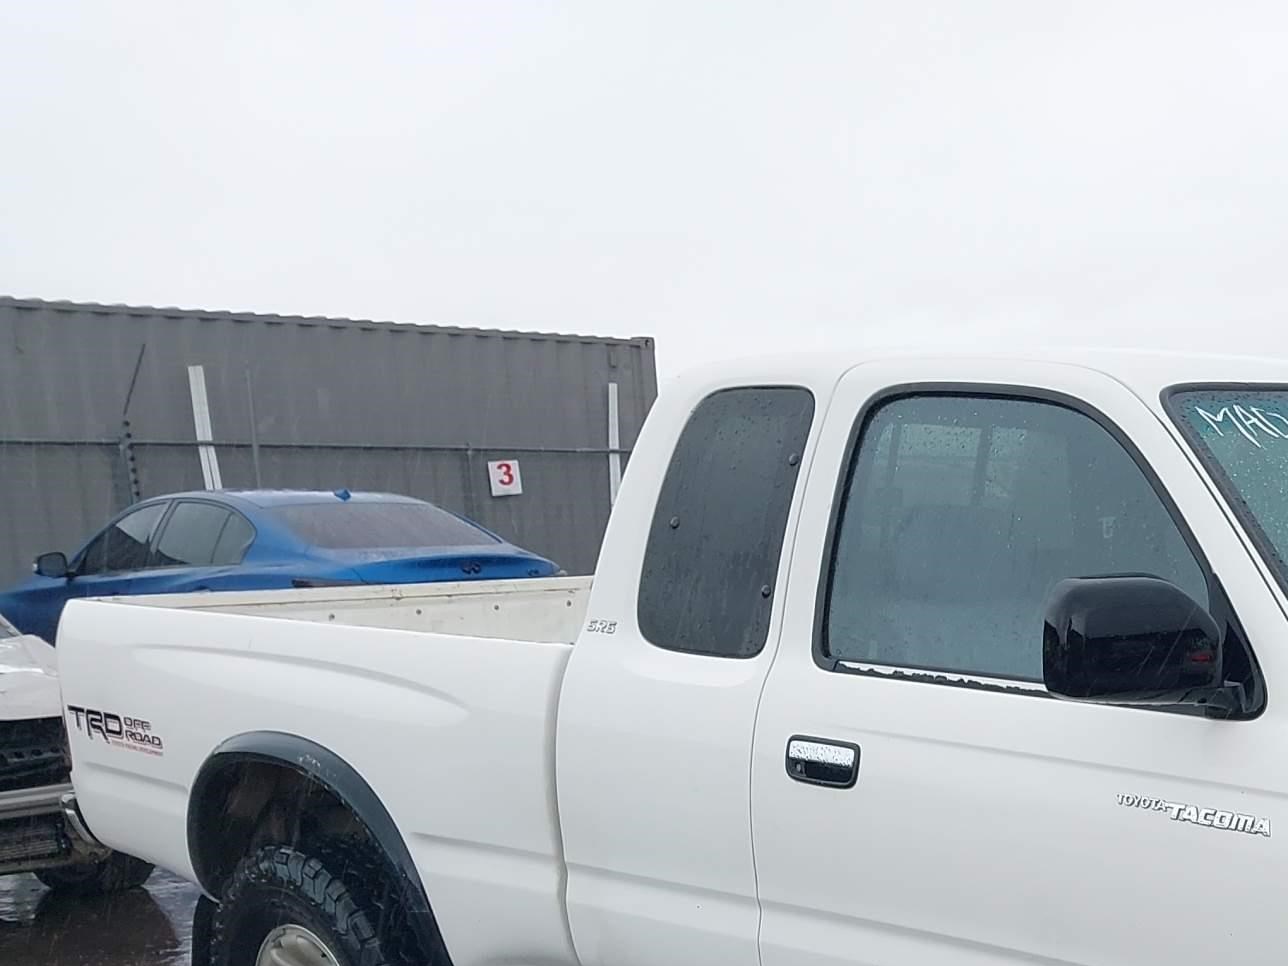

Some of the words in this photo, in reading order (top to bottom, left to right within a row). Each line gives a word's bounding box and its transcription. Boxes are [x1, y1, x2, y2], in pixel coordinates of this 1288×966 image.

[496, 463, 514, 486] 3
[67, 704, 123, 744] TRD
[123, 716, 152, 732] OFF
[124, 729, 163, 750] ROAD
[1117, 793, 1168, 812] TOYOTA
[1165, 802, 1272, 837] TACOMA
